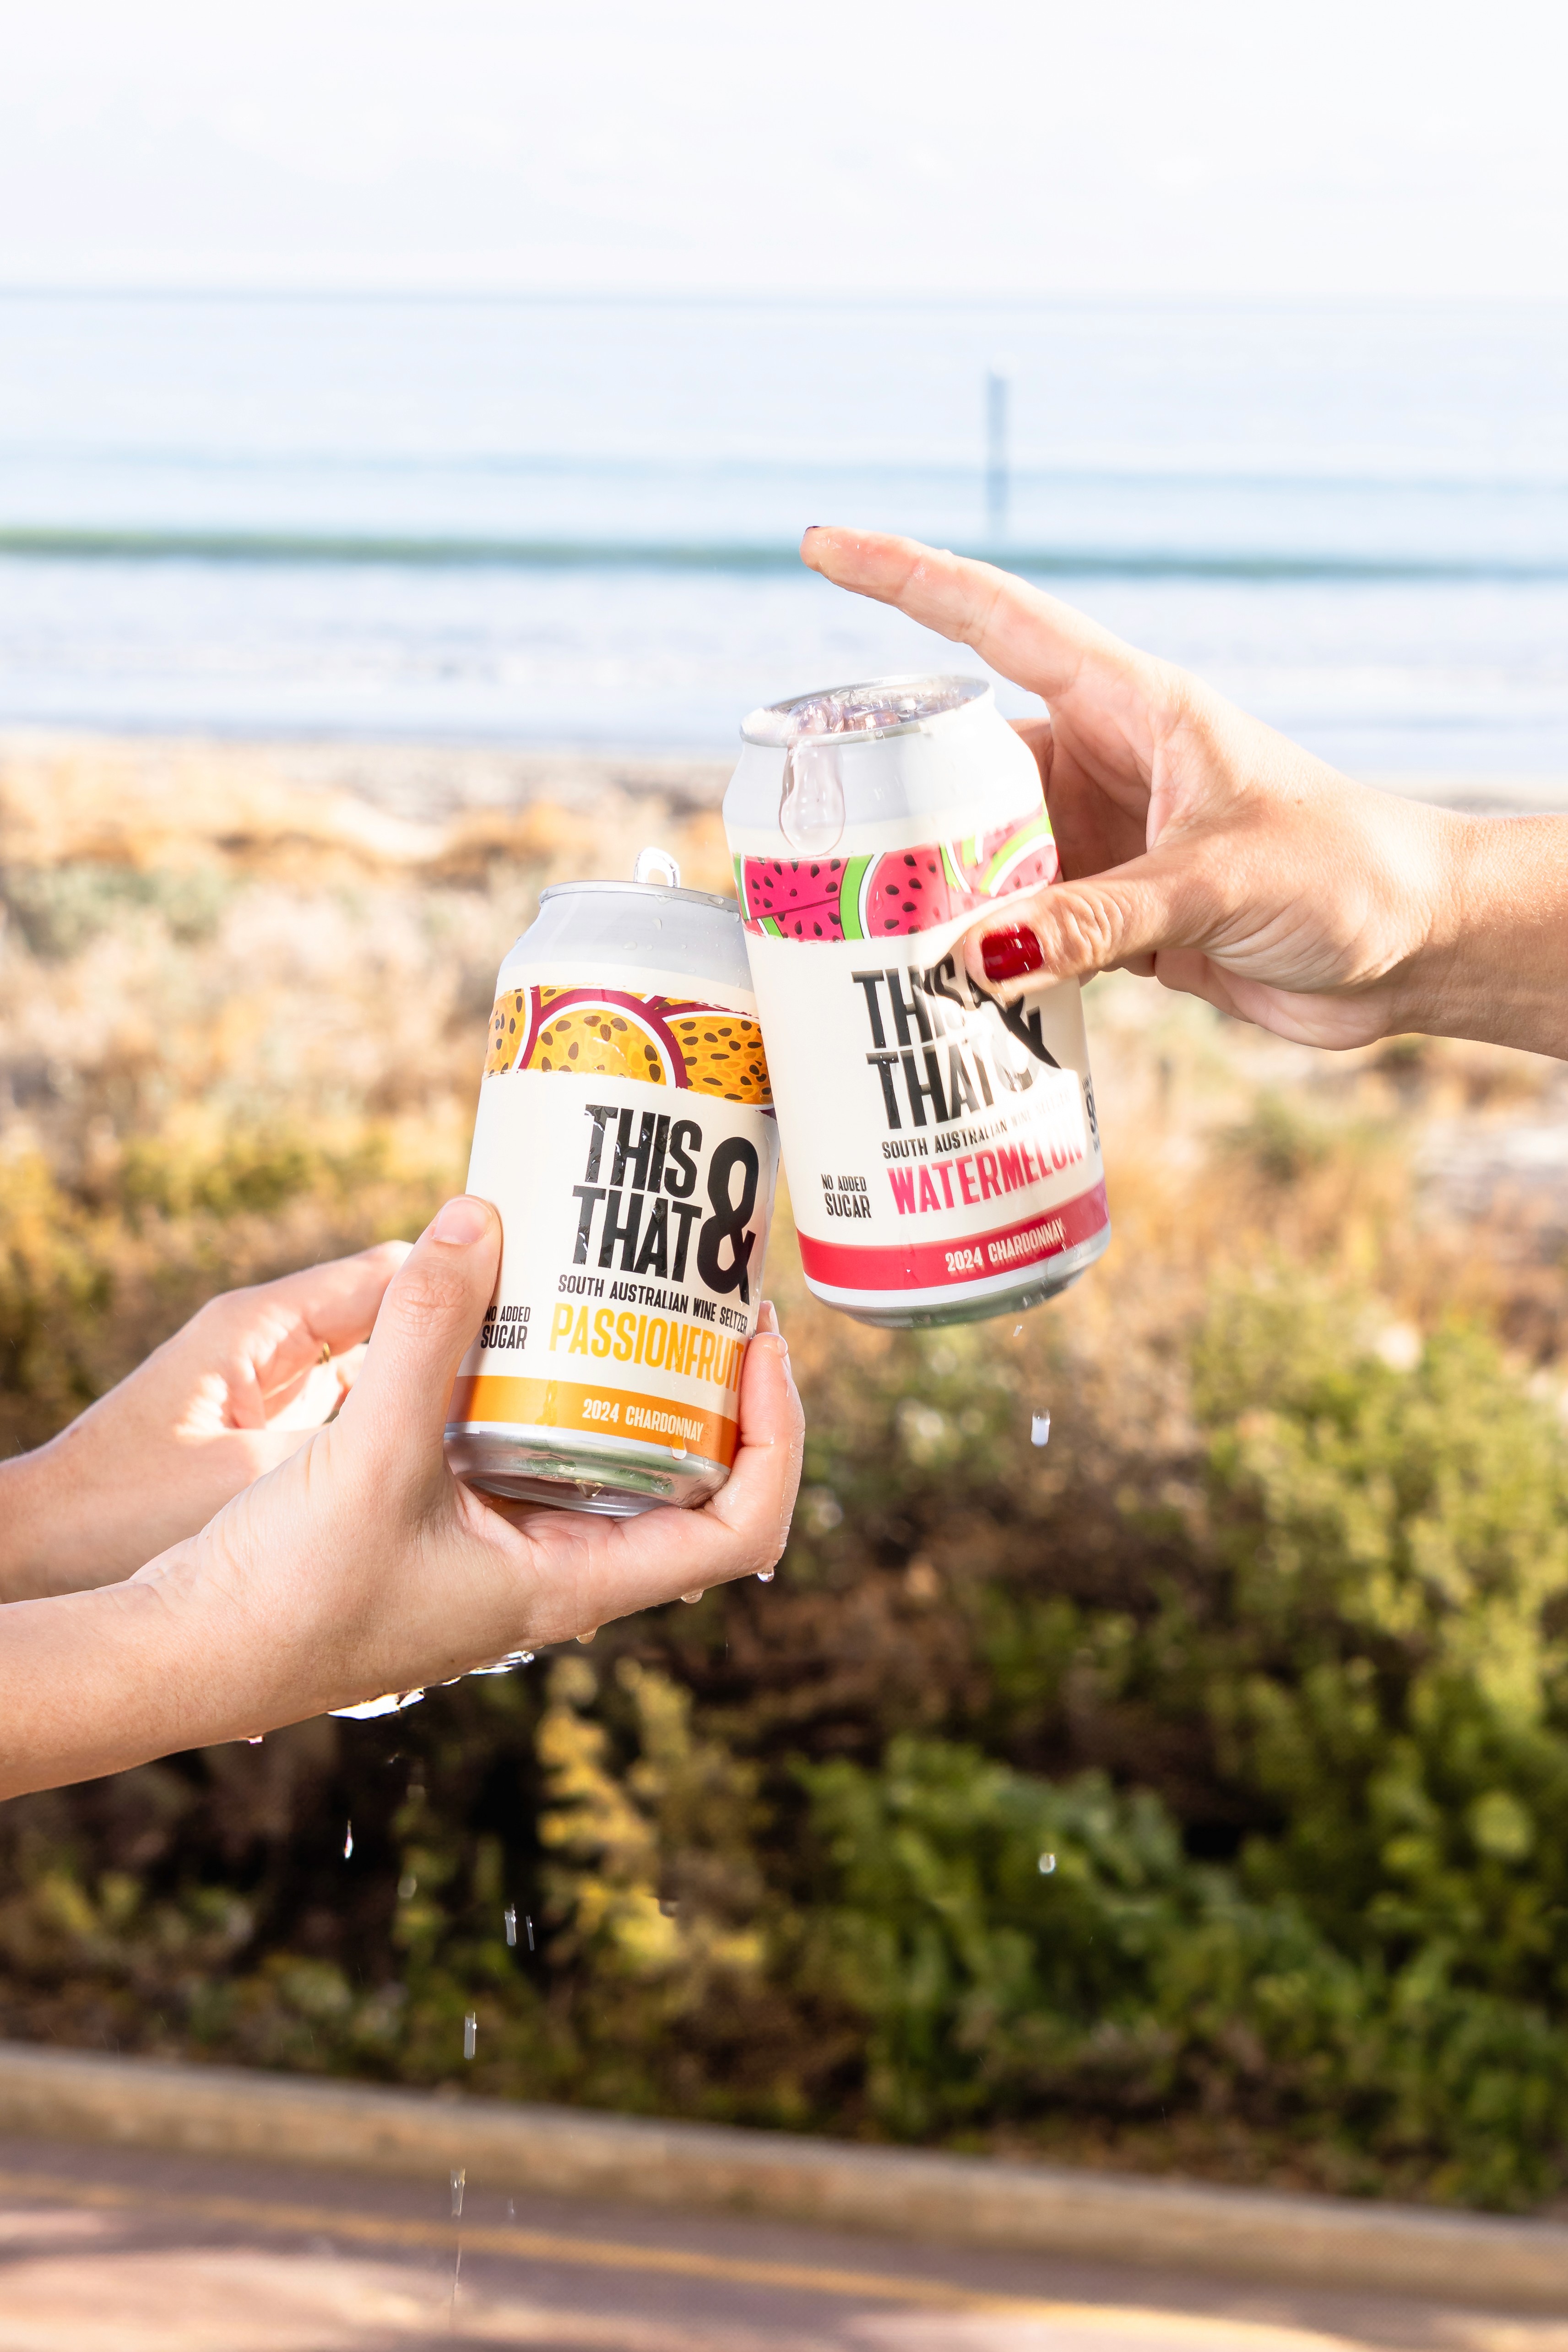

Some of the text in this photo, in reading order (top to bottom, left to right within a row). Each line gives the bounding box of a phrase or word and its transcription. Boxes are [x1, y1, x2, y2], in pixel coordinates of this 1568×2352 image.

[882, 1138, 928, 1159] SOUTH
[935, 1117, 1008, 1153] AUSTRALIAN
[821, 1173, 867, 1191] NO ADDED
[887, 1135, 1083, 1215] WATERMELON
[584, 1104, 759, 1305] THIS &
[824, 1192, 872, 1218] SUGAR
[572, 1185, 702, 1282] THAT
[945, 1217, 1065, 1272] 2024 CHARDONNAY
[485, 1306, 531, 1322] NO ADDED
[558, 1275, 748, 1336] SOUTH AUSTRALIAN WINE SELTZER
[480, 1325, 528, 1349] SUGAR
[548, 1303, 744, 1393] PASSIONFRUIT
[582, 1398, 704, 1442] 2024 CHARDONNAY
